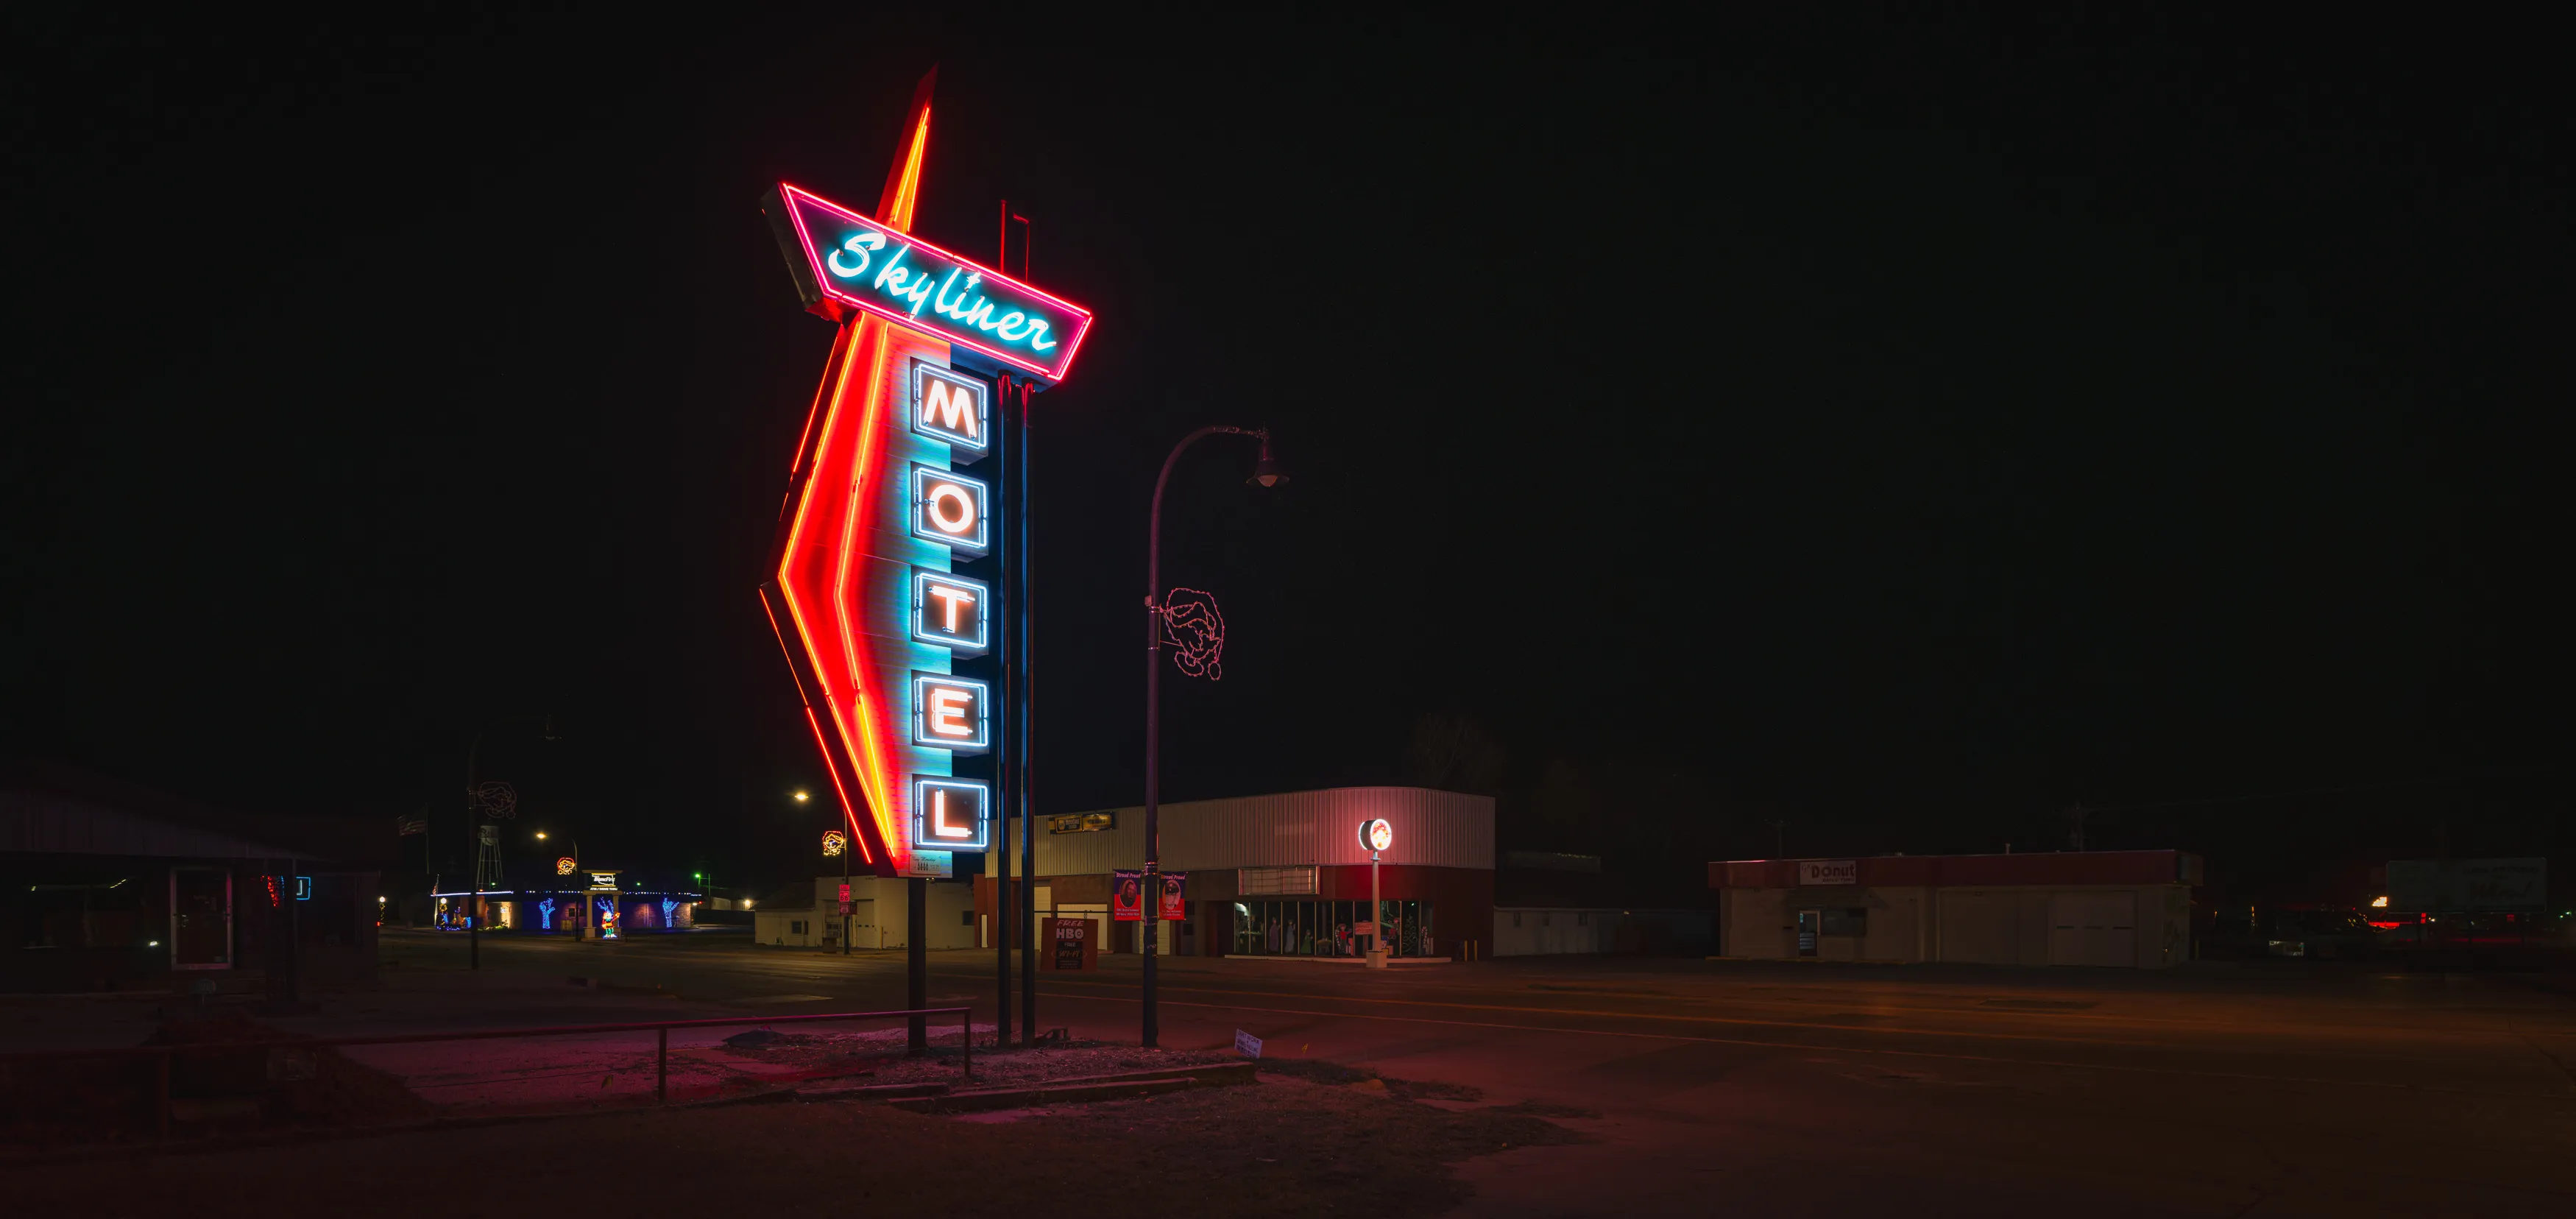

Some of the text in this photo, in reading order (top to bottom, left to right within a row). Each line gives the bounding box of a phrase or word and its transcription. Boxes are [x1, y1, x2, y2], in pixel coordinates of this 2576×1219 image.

[828, 233, 1058, 351] Skyliner
[922, 378, 979, 838] MOTEL
[1811, 864, 1855, 878] Donut
[1056, 928, 1084, 939] HBO
[1247, 1035, 1260, 1044] WORK
